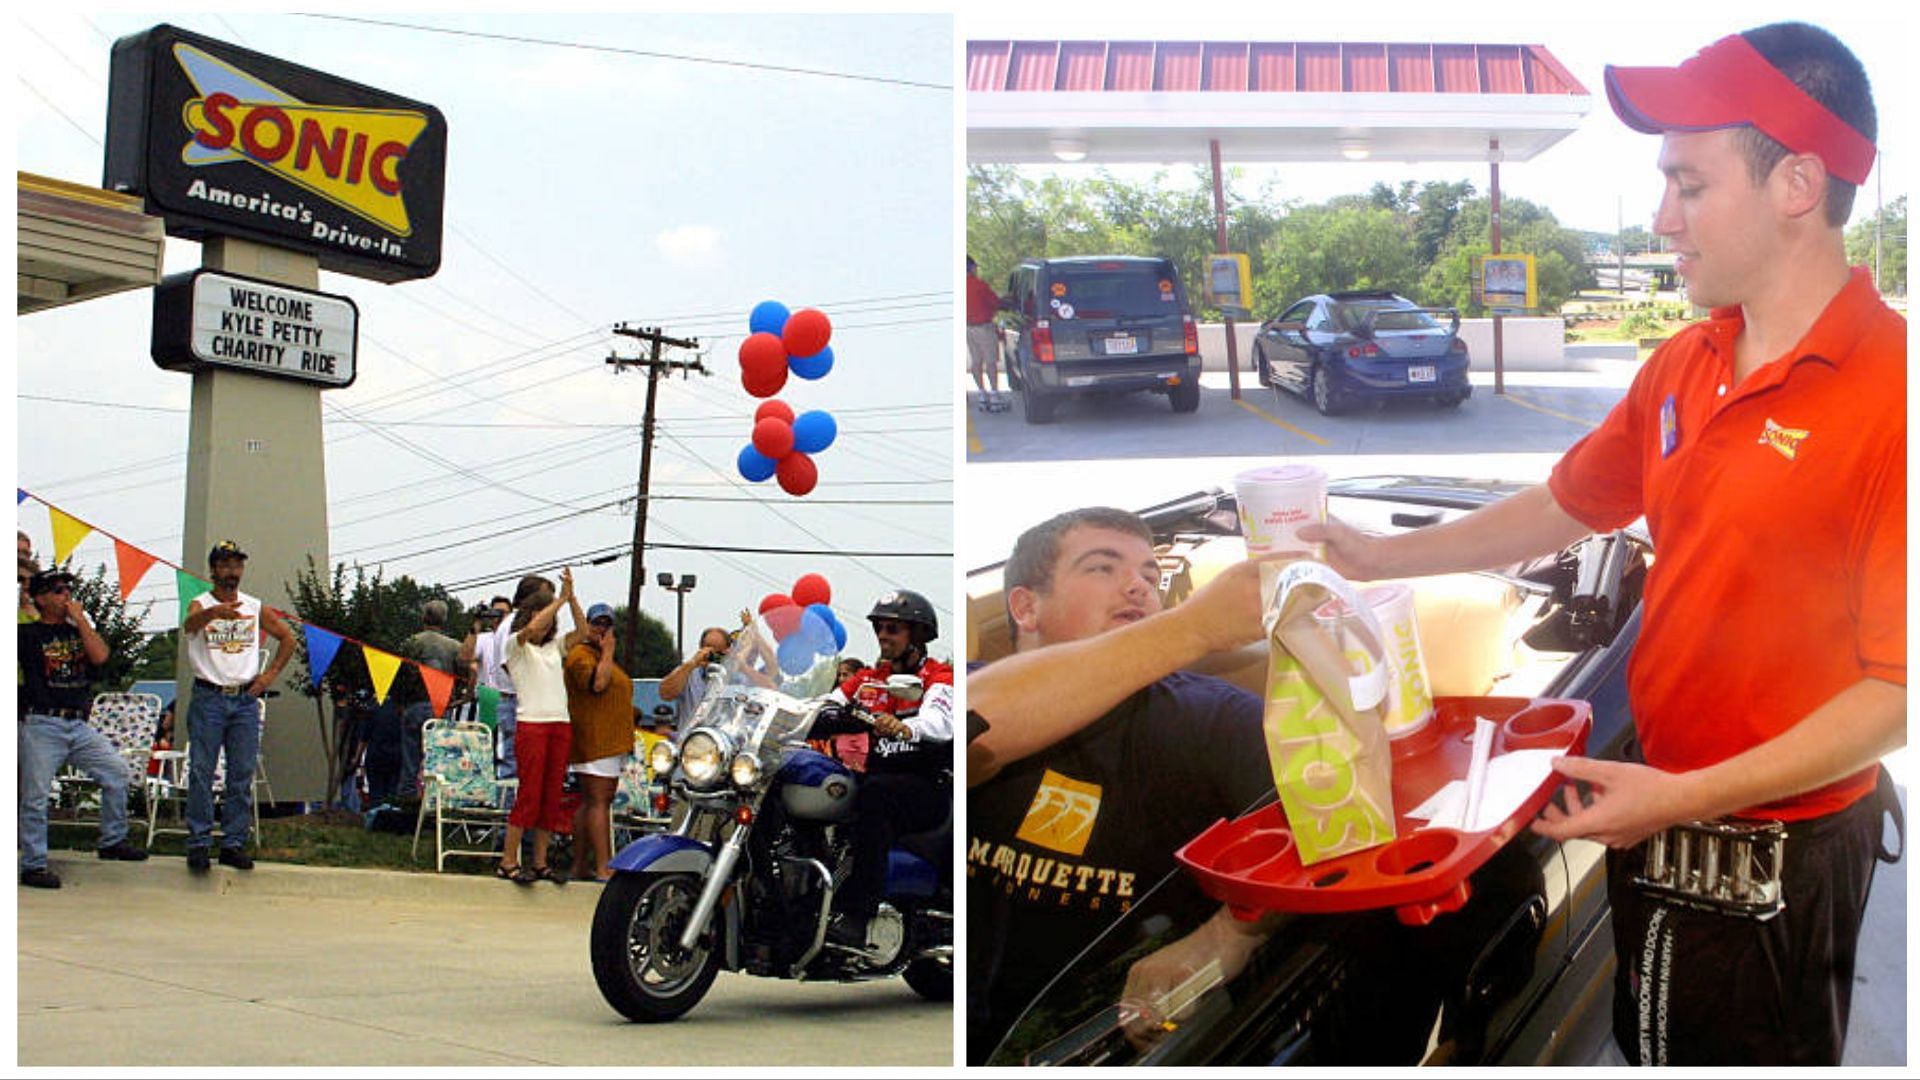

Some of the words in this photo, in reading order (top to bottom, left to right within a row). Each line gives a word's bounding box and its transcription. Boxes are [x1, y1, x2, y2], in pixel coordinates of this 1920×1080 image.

[195, 92, 408, 196] SONIC
[187, 179, 313, 223] America's
[312, 221, 402, 257] Drive-In
[230, 287, 313, 321] WELCOME
[221, 310, 264, 337] KYLE
[272, 320, 323, 347] PETTY
[211, 335, 286, 365] CHARITY
[301, 350, 336, 375] RIDE
[1760, 428, 1800, 450] SONIC
[968, 836, 1136, 897] MARQUETTE
[1642, 950, 1655, 975] AND
[1660, 934, 1673, 981] MARVIN
[1639, 975, 1653, 1030] WINDOWS
[1657, 982, 1669, 1039] WINDOWS
